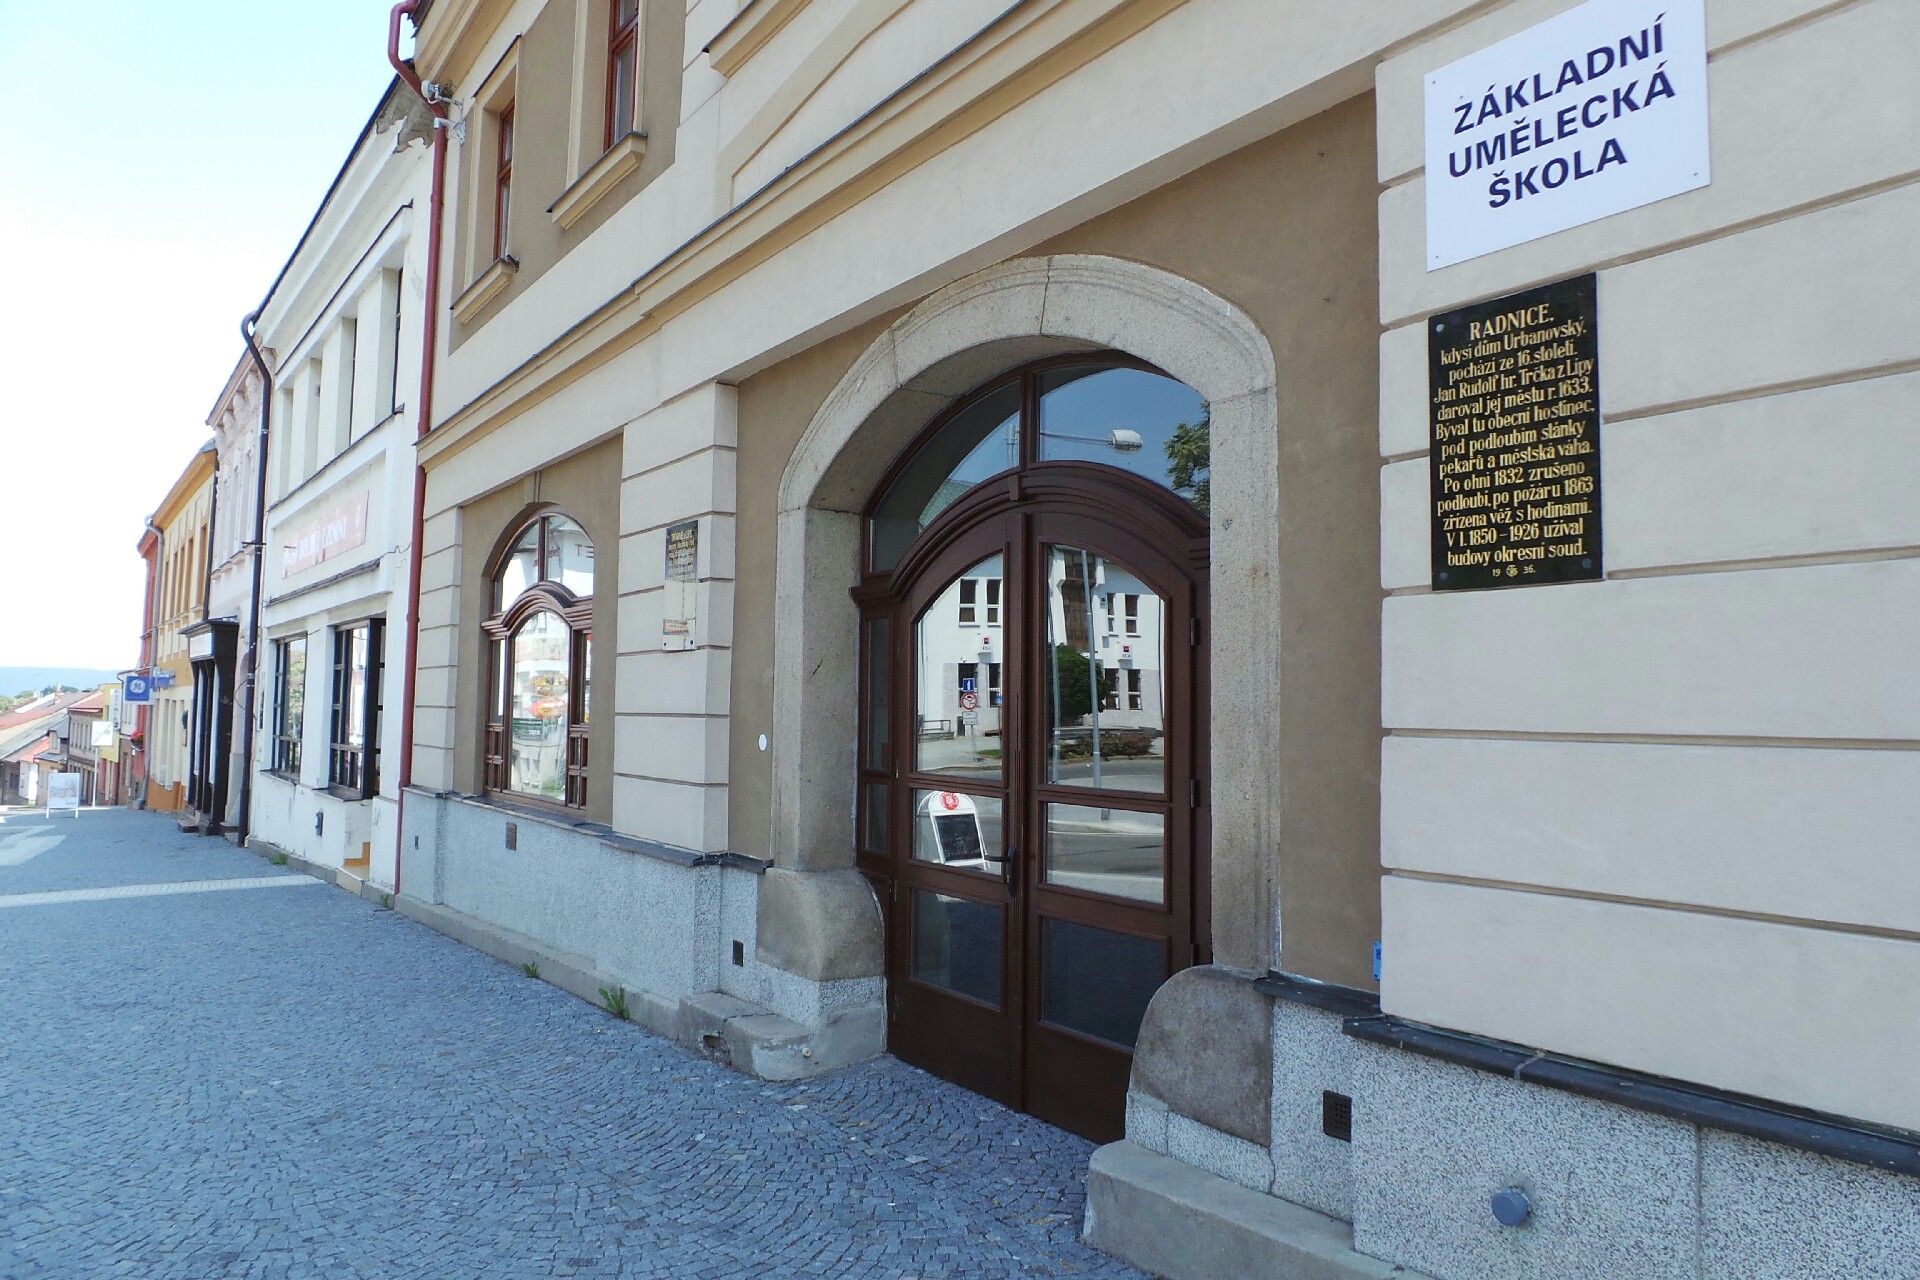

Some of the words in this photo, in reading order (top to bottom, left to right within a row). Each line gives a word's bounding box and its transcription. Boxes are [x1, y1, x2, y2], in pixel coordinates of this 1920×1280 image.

[1454, 11, 1667, 135] ZÁKLADNÍ
[1449, 60, 1676, 178] UMĚLECKÁ
[1489, 137, 1627, 209] ŠKOLA
[1470, 303, 1554, 340] RADNICE.
[1441, 344, 1472, 365] kdysi
[1474, 339, 1501, 357] dům
[1434, 384, 1456, 403] Jan
[1459, 374, 1498, 398] Rudolf
[1500, 376, 1517, 390] hr.
[1519, 365, 1555, 386] Trčka
[1557, 364, 1565, 378] z
[1449, 358, 1496, 385] pochází
[1499, 358, 1513, 370] ze
[1438, 398, 1483, 420] daroval
[1484, 394, 1501, 415] jej
[1505, 390, 1544, 408] městu
[1548, 388, 1557, 399] r.
[1436, 419, 1469, 441] Býval
[1473, 417, 1485, 432] tu
[1488, 407, 1531, 429] obecní
[1442, 439, 1465, 460] pod
[1469, 428, 1537, 456] podloubím
[1541, 420, 1586, 439] stánky
[1440, 455, 1484, 479] pekařů
[1488, 455, 1496, 468] a
[1500, 442, 1555, 466] městská
[1444, 478, 1460, 493] Po
[1464, 472, 1491, 492] ohni
[1494, 467, 1524, 486] 1832
[1528, 461, 1585, 482] zrušeno
[1492, 491, 1509, 509] po
[1514, 484, 1560, 506] požáru
[1563, 477, 1594, 495] 1863
[1443, 514, 1487, 531] zřízena
[1490, 509, 1512, 524] věž
[1516, 508, 1524, 522] s
[1447, 532, 1457, 548] V
[1469, 528, 1497, 546] 1850
[1509, 523, 1540, 541] 1926
[1543, 518, 1584, 538] užíval
[1448, 550, 1491, 567] budovy
[1494, 541, 1545, 562] okresní
[1548, 538, 1588, 557] soud.
[1492, 568, 1501, 577] 19
